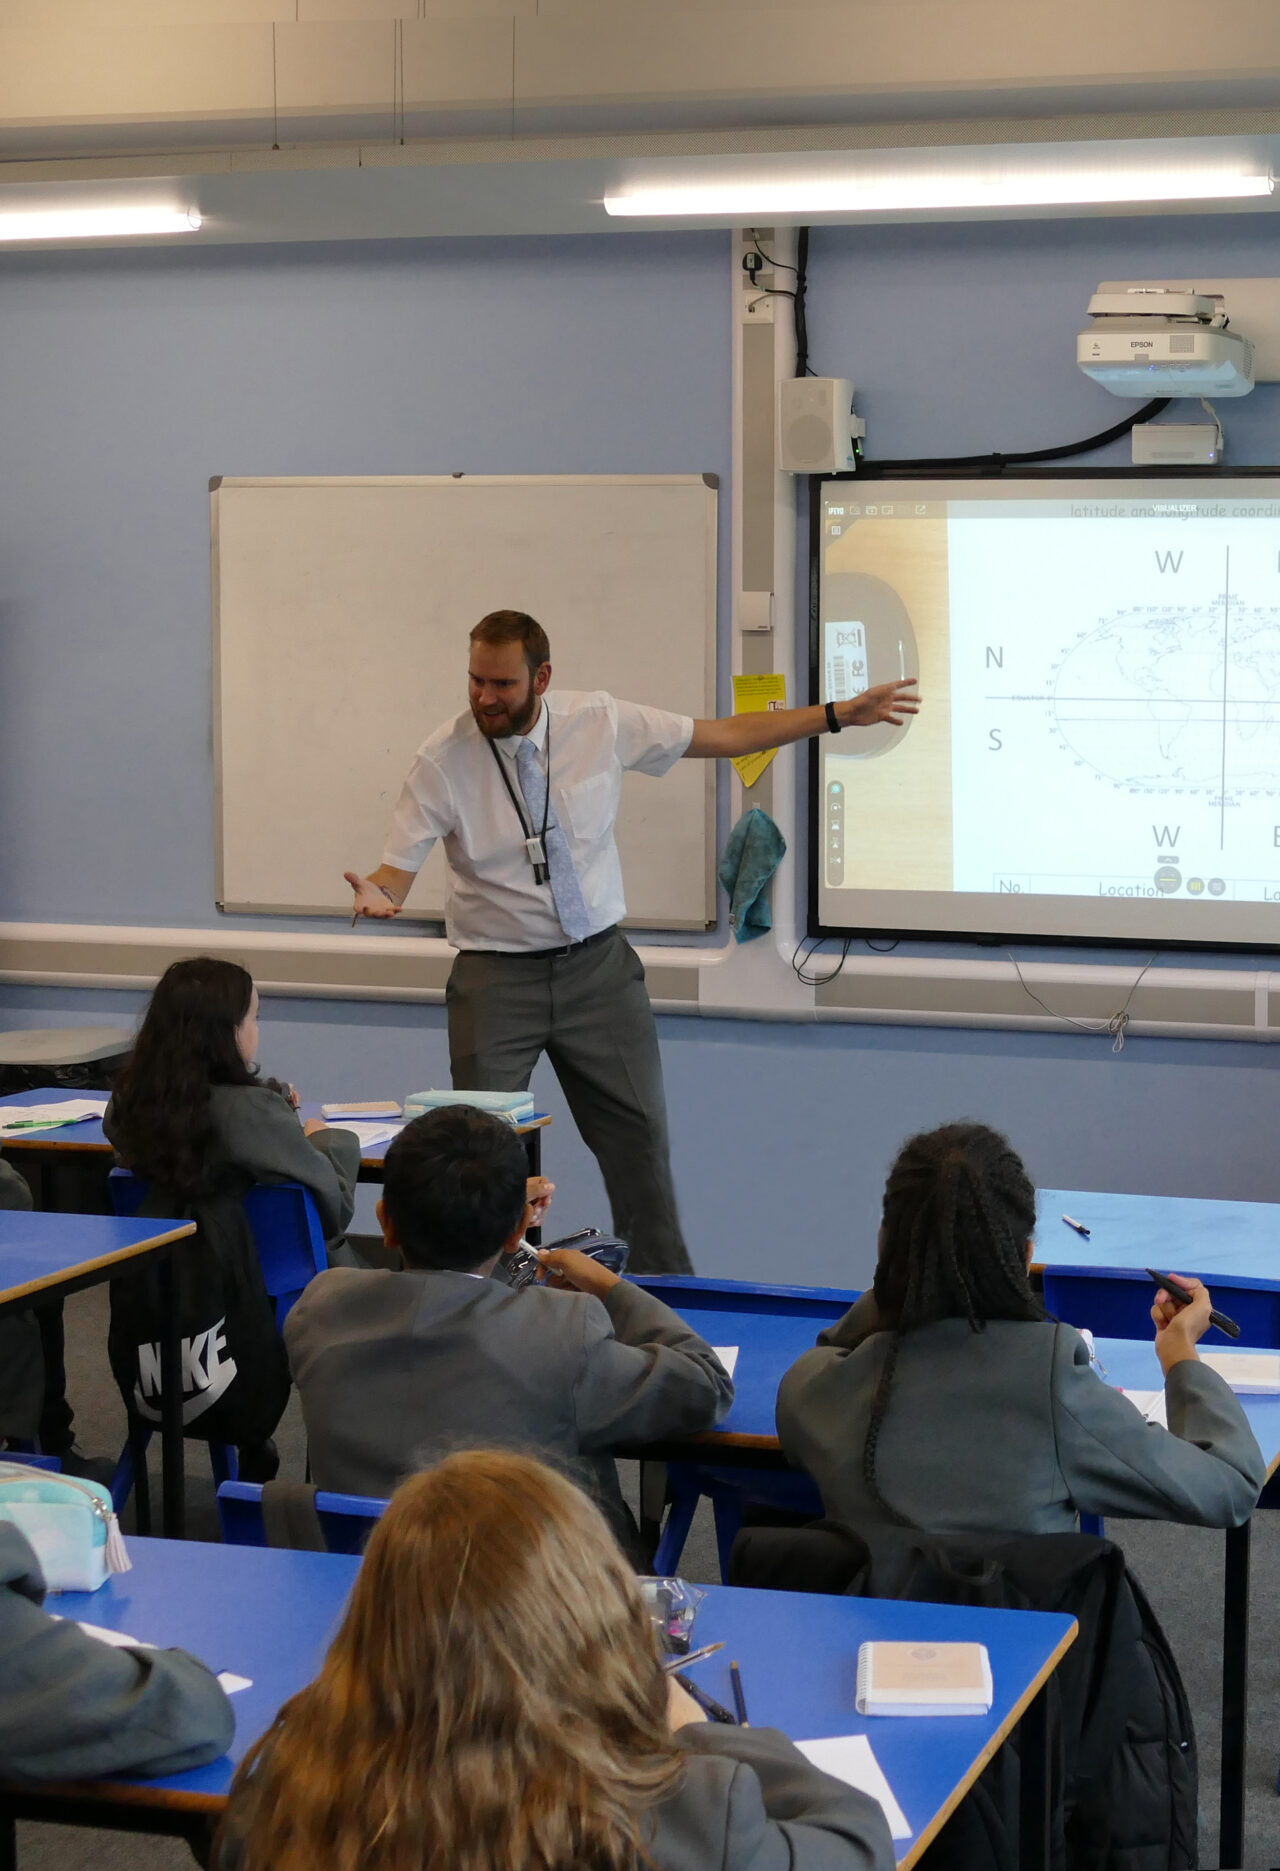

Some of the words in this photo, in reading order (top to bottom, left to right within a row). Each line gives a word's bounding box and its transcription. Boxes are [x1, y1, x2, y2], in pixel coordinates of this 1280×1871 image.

[1130, 341, 1153, 349] EPSON
[1070, 503, 1126, 518] latitude
[1152, 504, 1198, 512] VISUALIZER
[1155, 550, 1184, 574] W
[986, 645, 1004, 669] N
[988, 728, 1002, 751] S
[1152, 825, 1181, 848] W
[999, 879, 1025, 894] No.
[1098, 882, 1165, 897] Location
[138, 1328, 238, 1398] NKE
